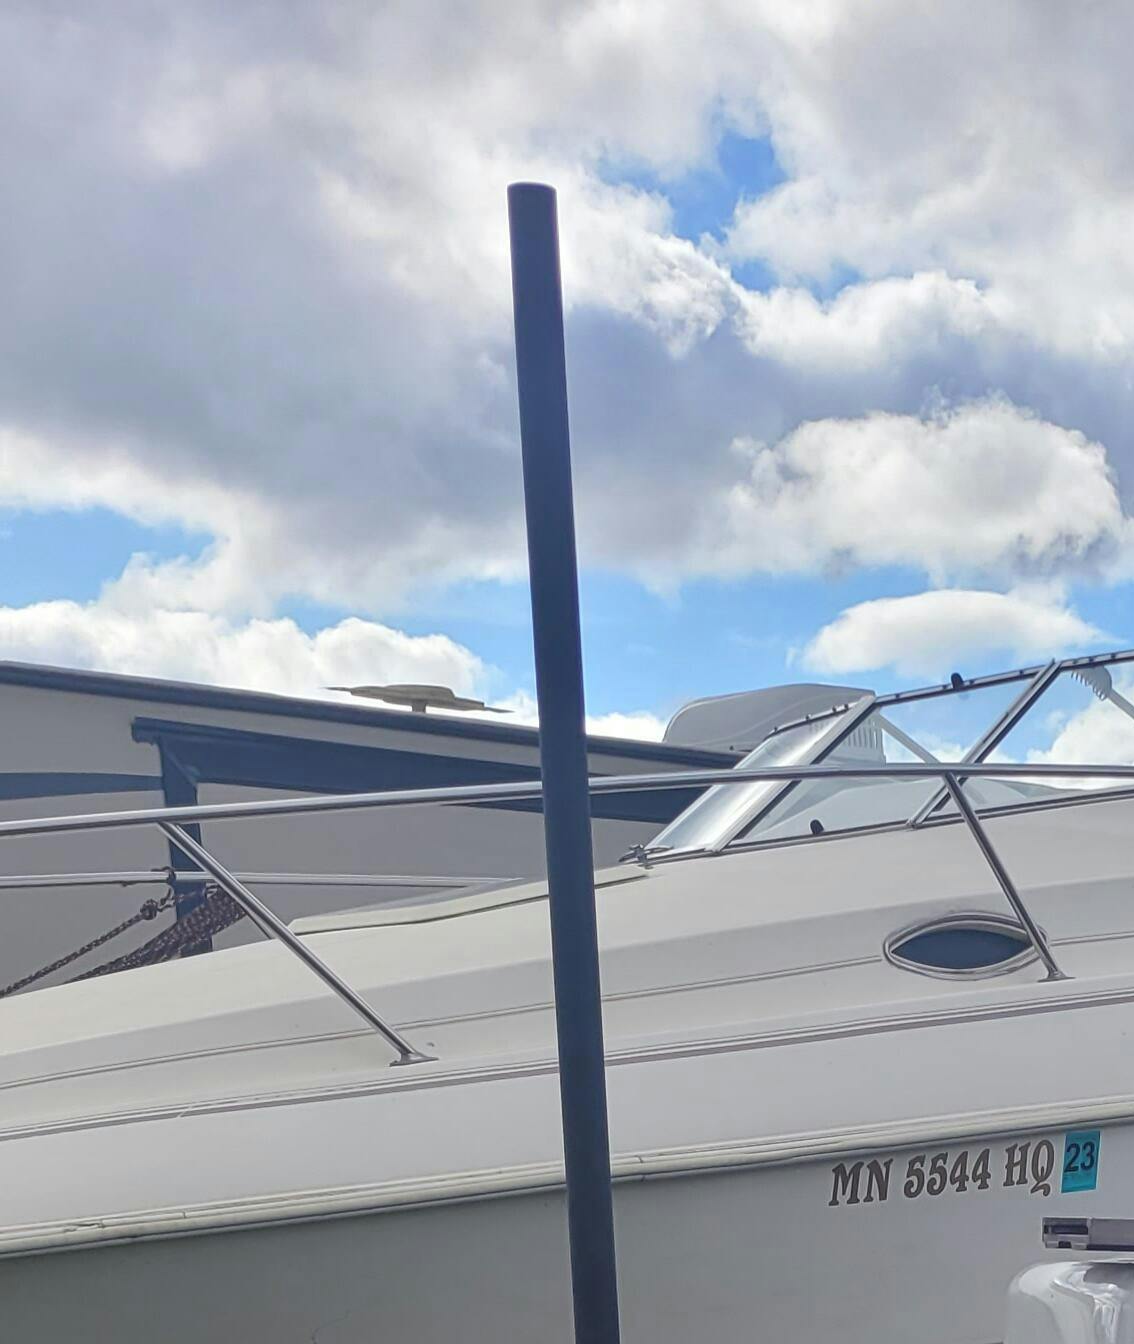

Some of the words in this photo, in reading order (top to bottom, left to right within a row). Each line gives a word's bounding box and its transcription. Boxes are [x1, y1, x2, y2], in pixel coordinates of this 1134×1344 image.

[828, 1157, 893, 1206] MN
[904, 1148, 991, 1198] 5544
[1003, 1139, 1055, 1197] HQ
[1064, 1141, 1095, 1172] 23
